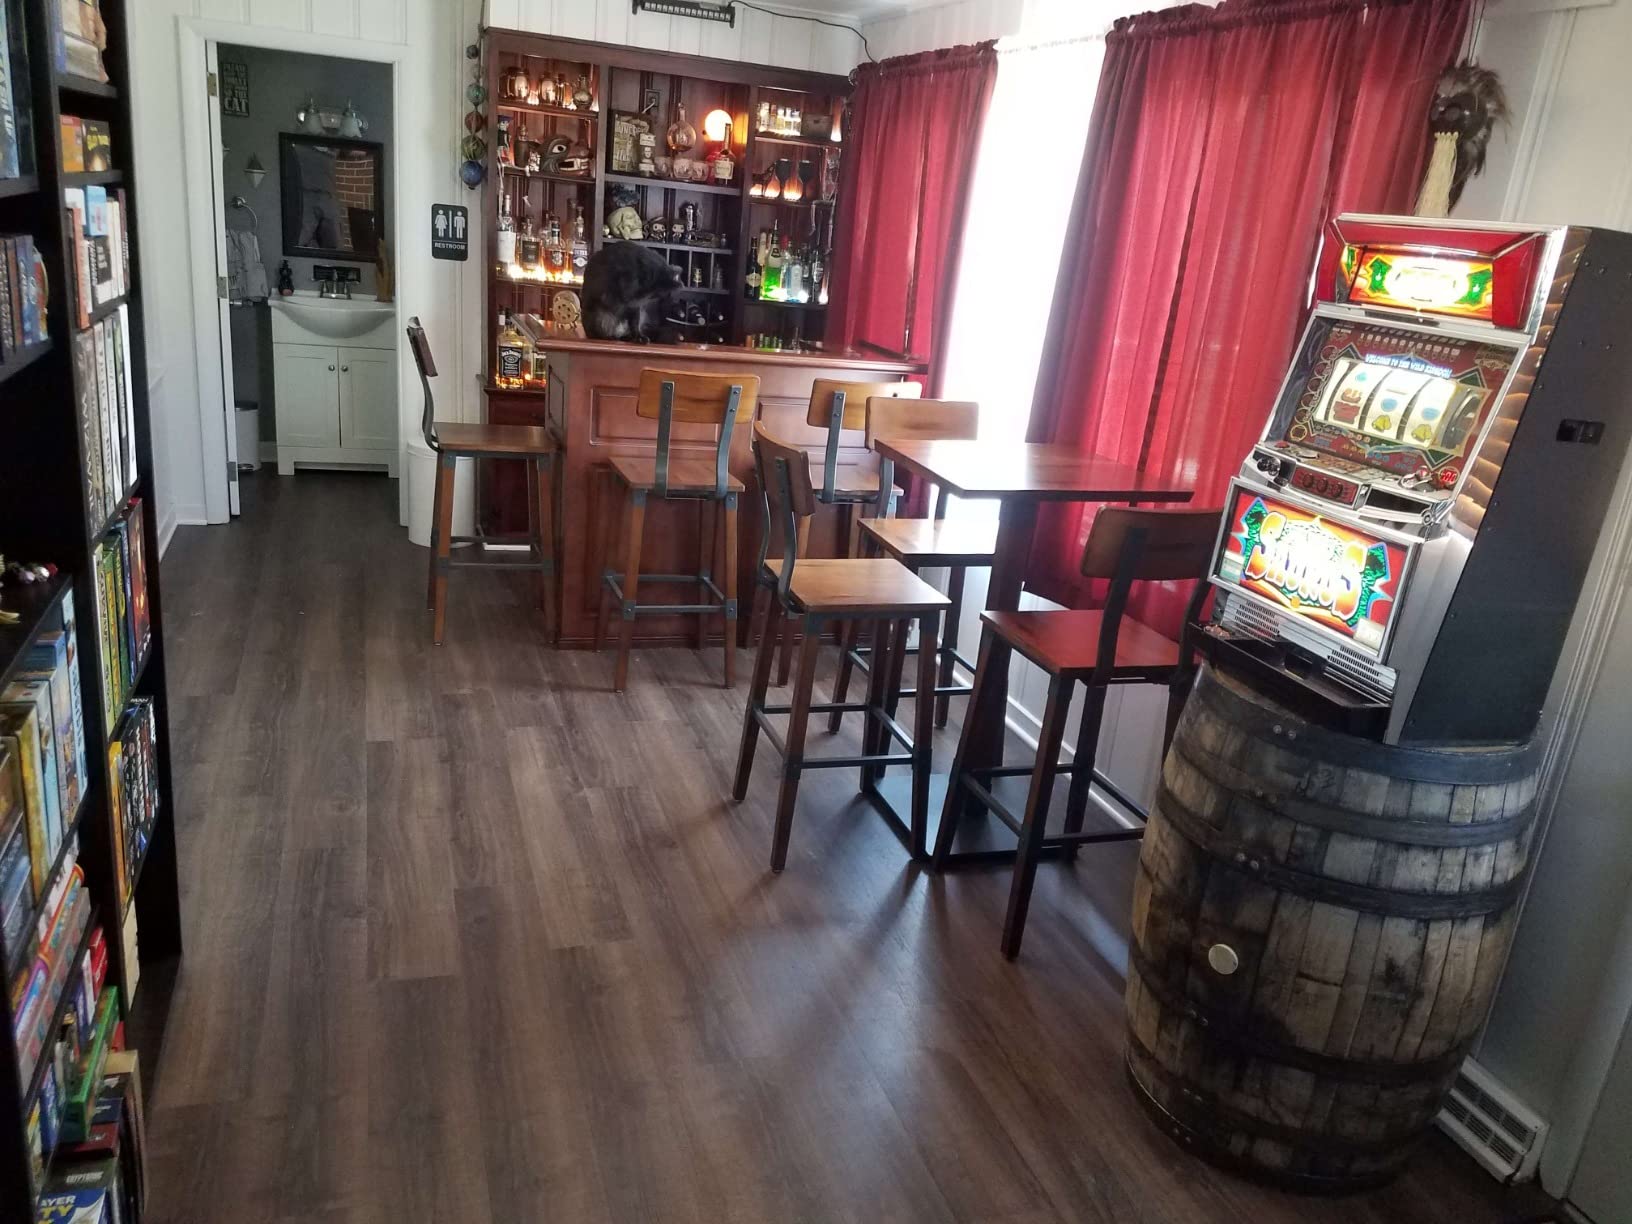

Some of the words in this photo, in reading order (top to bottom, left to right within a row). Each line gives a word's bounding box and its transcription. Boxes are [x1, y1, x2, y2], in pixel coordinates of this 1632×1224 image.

[224, 97, 249, 112] CAT
[434, 242, 466, 250] RESTROOM
[40, 1195, 76, 1207] AYER
[40, 1205, 74, 1218] TY
